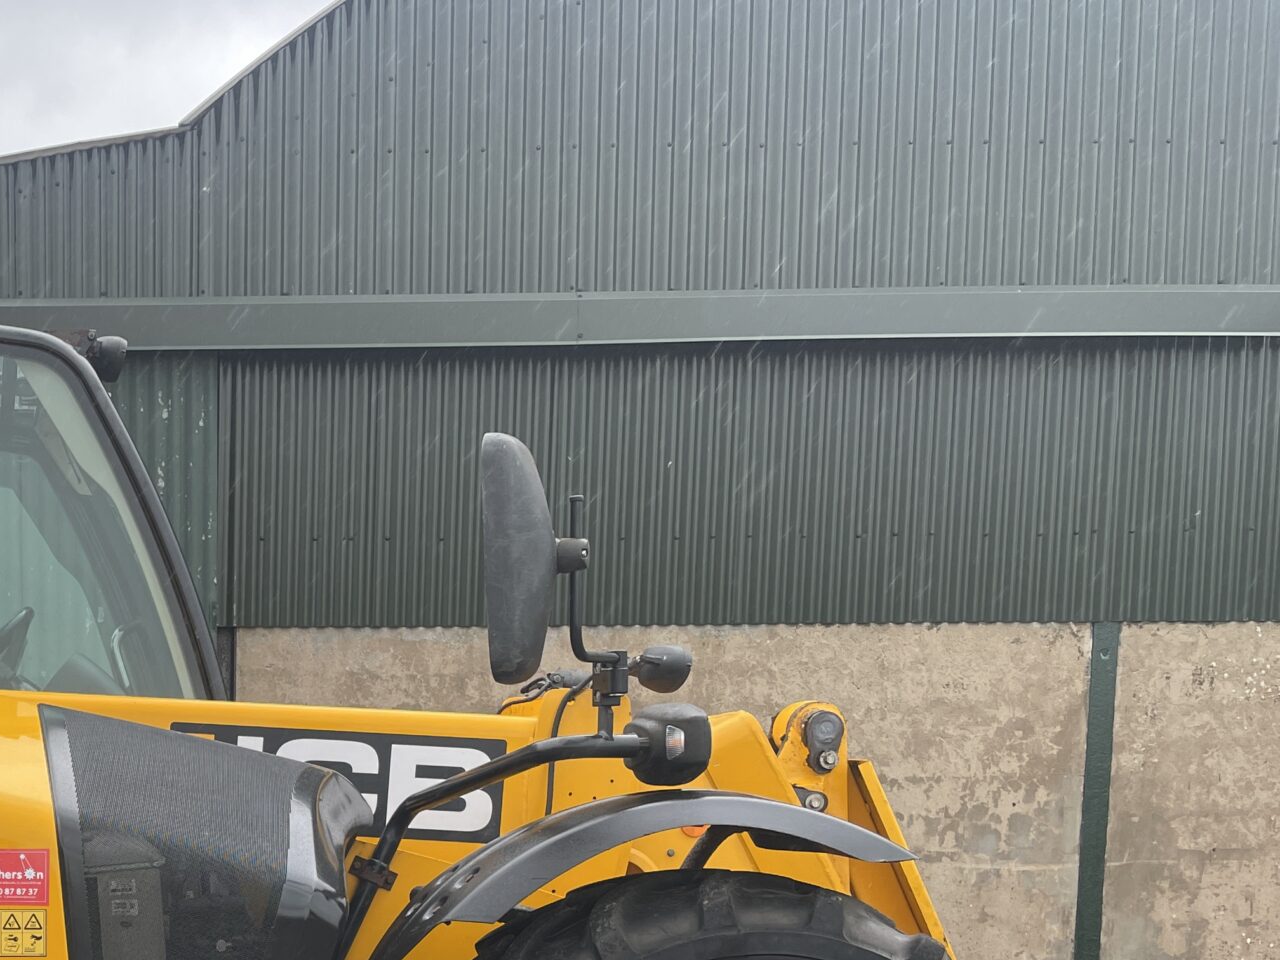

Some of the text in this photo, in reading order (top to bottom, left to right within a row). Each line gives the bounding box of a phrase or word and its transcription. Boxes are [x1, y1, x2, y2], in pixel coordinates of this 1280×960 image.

[4, 887, 15, 895] 87
[16, 888, 28, 896] 87
[28, 888, 39, 896] 37
